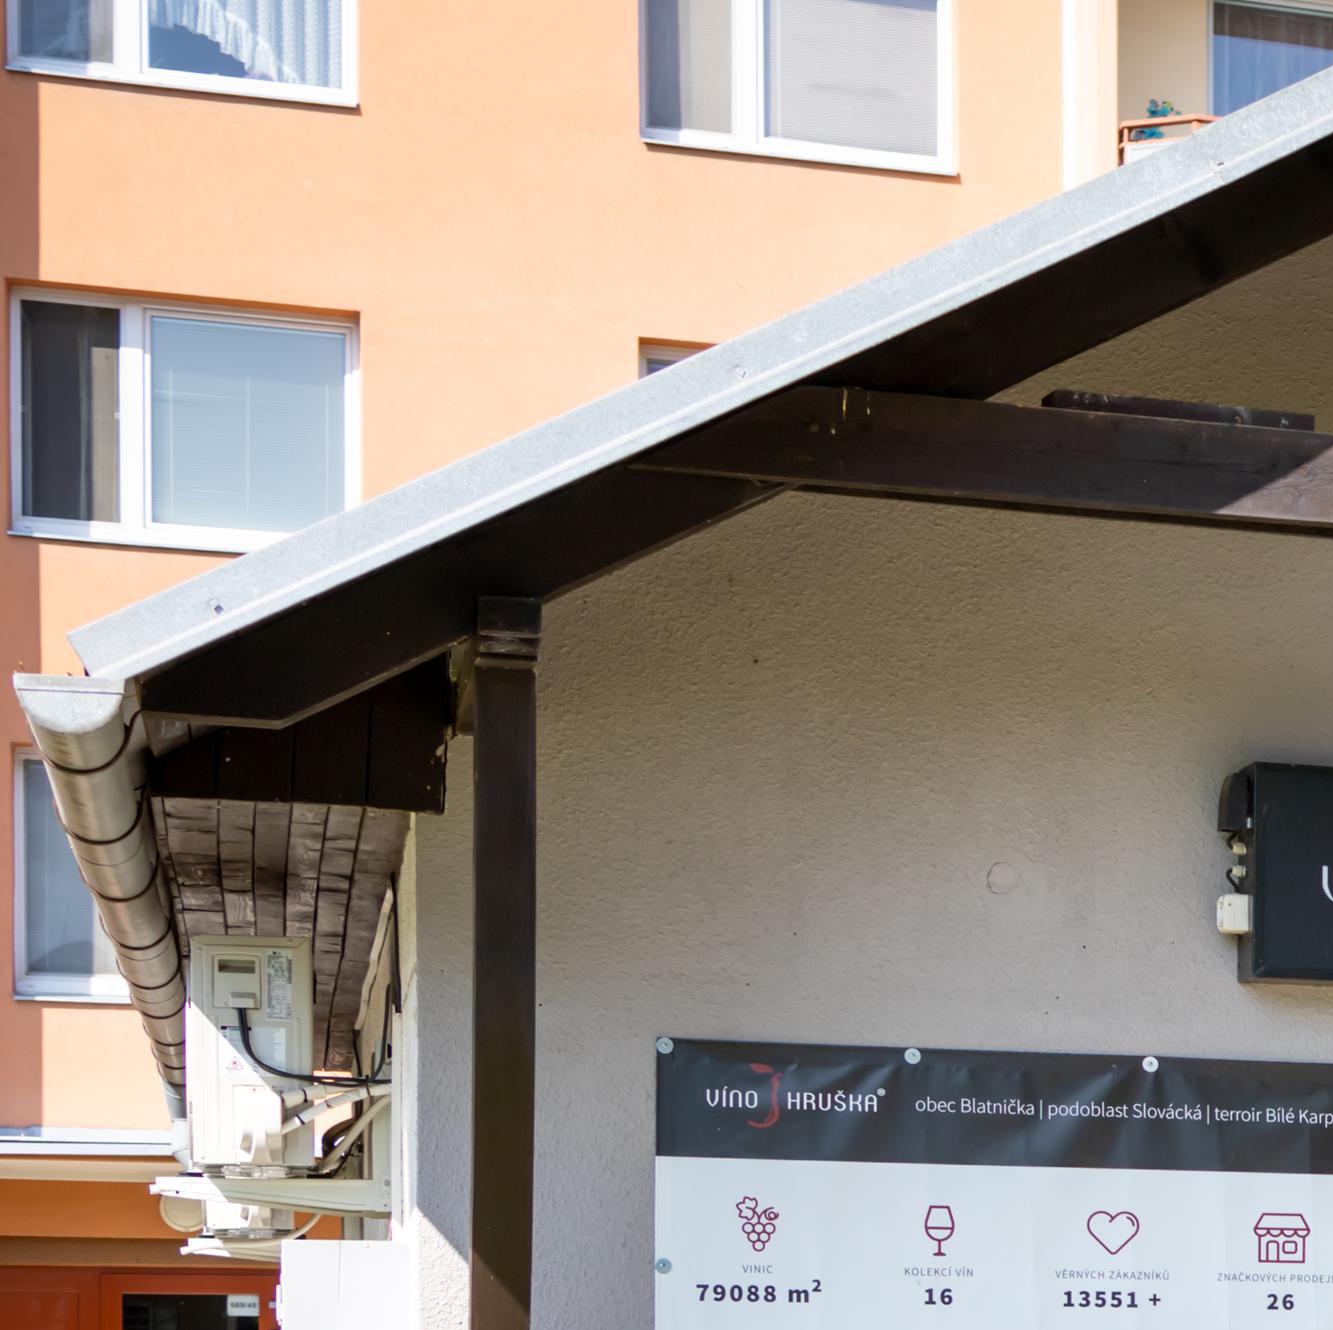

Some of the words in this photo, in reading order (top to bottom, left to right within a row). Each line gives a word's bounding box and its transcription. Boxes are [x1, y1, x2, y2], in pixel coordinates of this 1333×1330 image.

[914, 1096, 957, 1113] obec
[960, 1097, 1035, 1116] Blatnička
[1047, 1101, 1129, 1120] podoblast
[1132, 1103, 1202, 1121] Slovácká
[1214, 1106, 1262, 1123] terroir
[1265, 1107, 1295, 1124] Bílé
[742, 1264, 774, 1275] VINIC
[904, 1266, 952, 1277] KOLEKCÍ
[955, 1267, 974, 1278] VÍN
[1055, 1269, 1105, 1280] VĚRNÝCH
[1108, 1269, 1170, 1281] ZÁKAZNÍKŮ
[1217, 1272, 1287, 1283] ZNAČKOVÝCH
[695, 1283, 778, 1303] 79088
[923, 1287, 954, 1306] 16
[1062, 1289, 1139, 1309] 13551
[1266, 1293, 1295, 1311] 26
